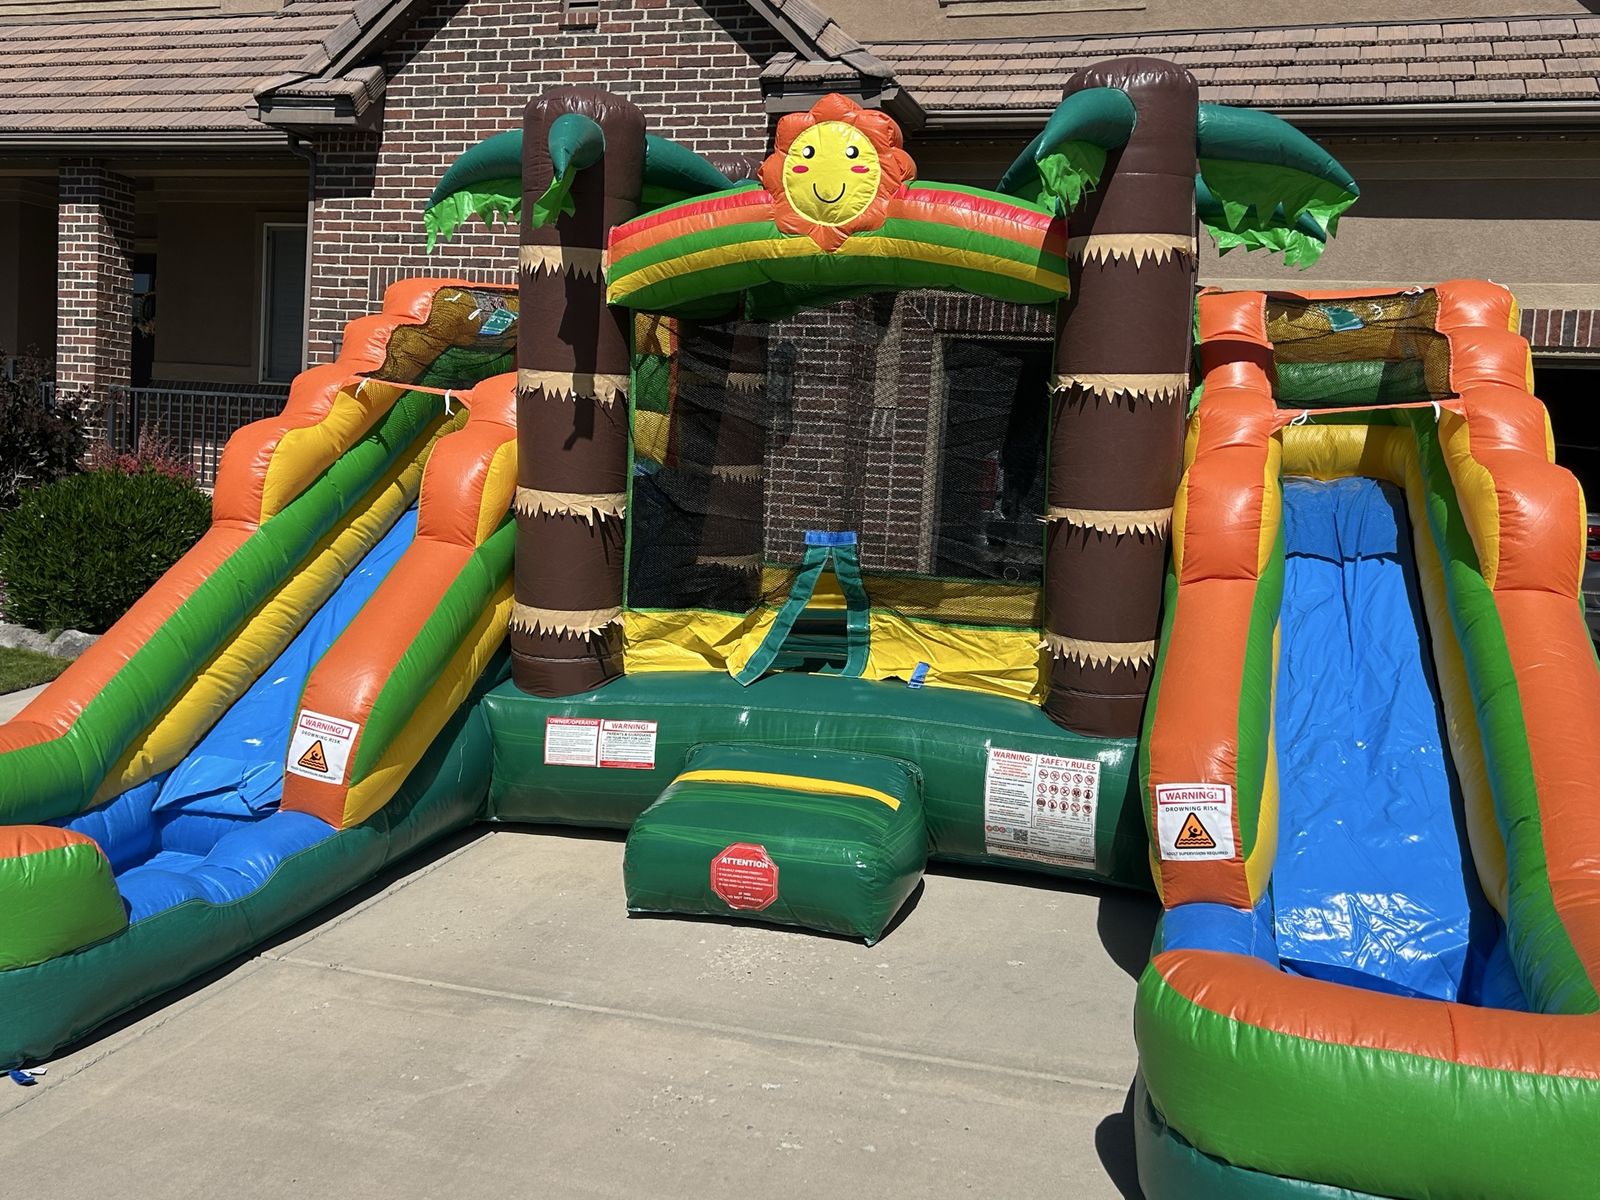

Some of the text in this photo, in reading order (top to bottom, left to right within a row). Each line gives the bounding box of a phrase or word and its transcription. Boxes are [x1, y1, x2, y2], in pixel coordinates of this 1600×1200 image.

[305, 718, 344, 735] WARNING!
[611, 722, 649, 731] WARNING!
[301, 729, 341, 745] DROWNING RISK
[993, 750, 1033, 762] WARNING:
[1071, 760, 1096, 771] RULES
[1165, 791, 1217, 801] WARNING!
[721, 856, 768, 869] ATTENTION
